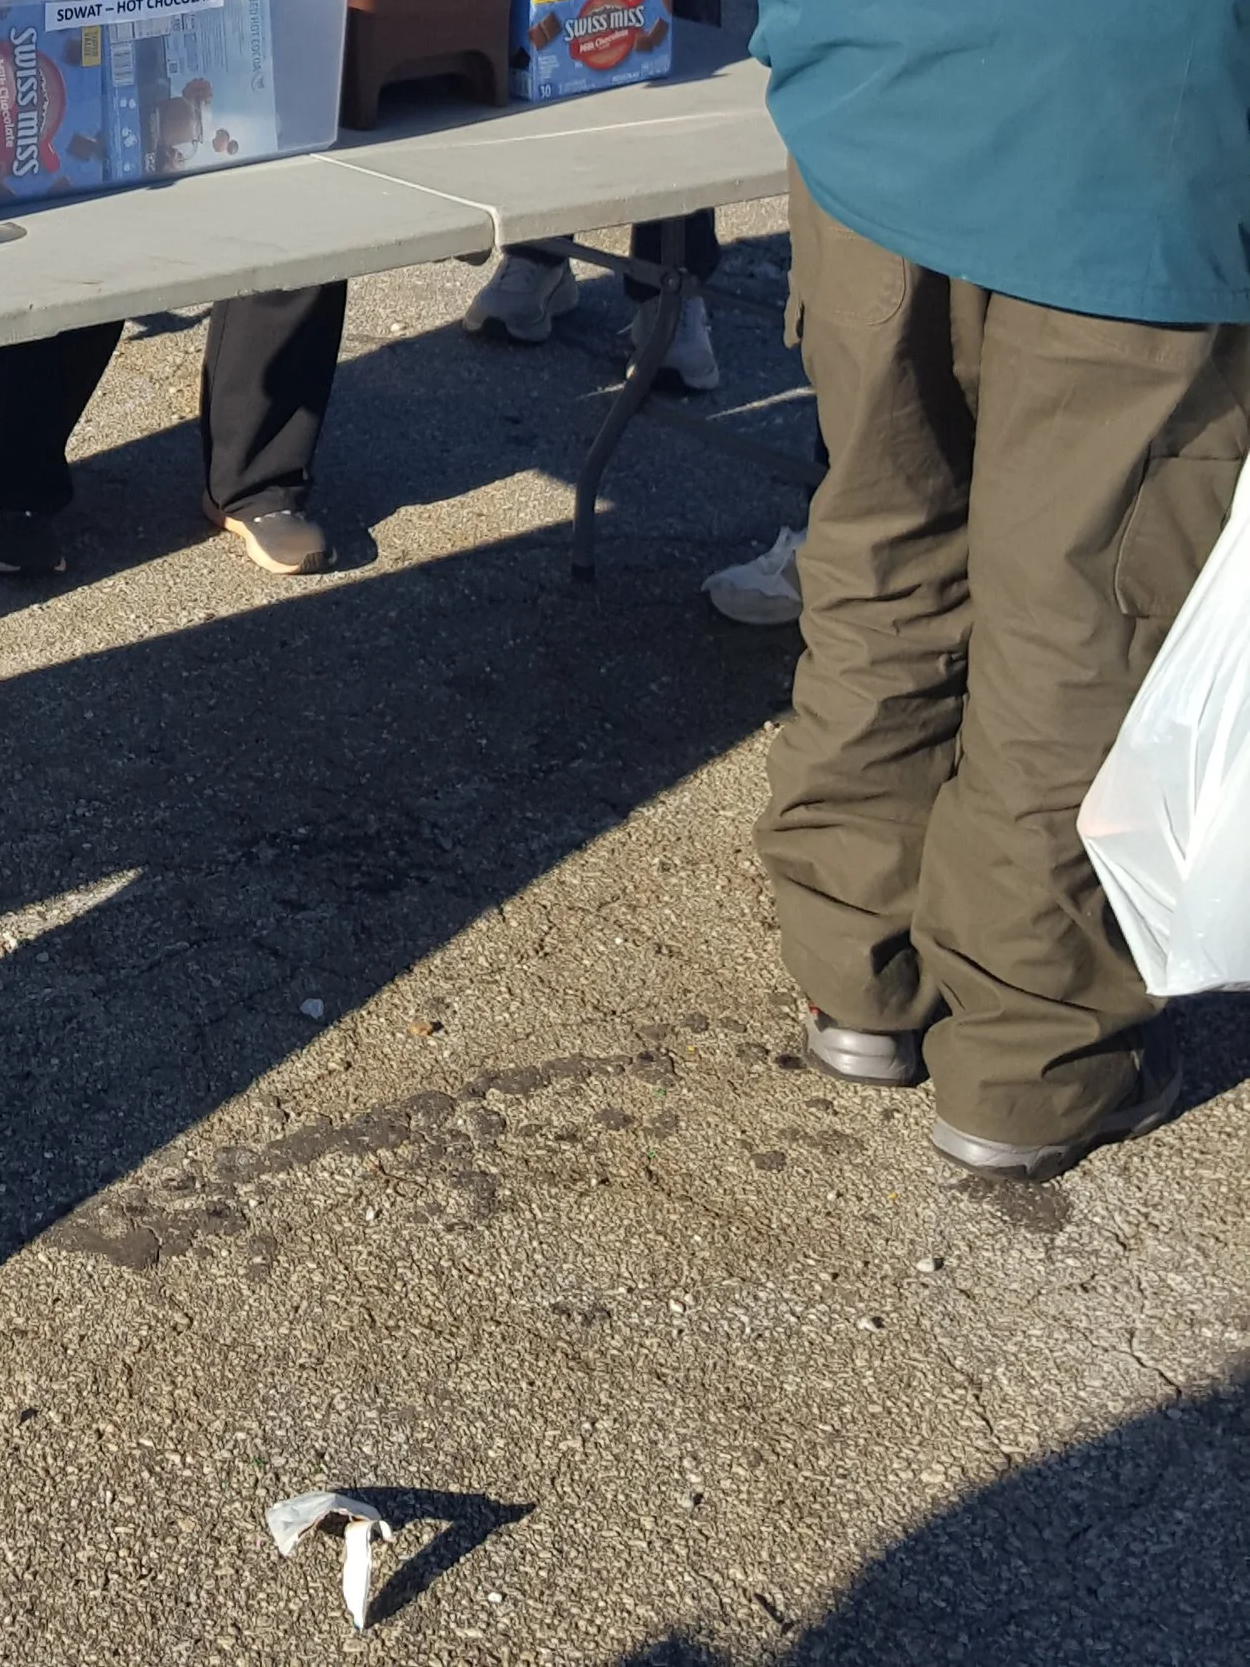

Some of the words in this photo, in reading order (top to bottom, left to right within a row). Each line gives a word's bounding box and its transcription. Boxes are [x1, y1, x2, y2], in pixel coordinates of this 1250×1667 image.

[56, 3, 103, 22] SDWAT
[564, 14, 608, 42] SWISS
[10, 27, 38, 107] SWISS
[540, 85, 552, 98] 30
